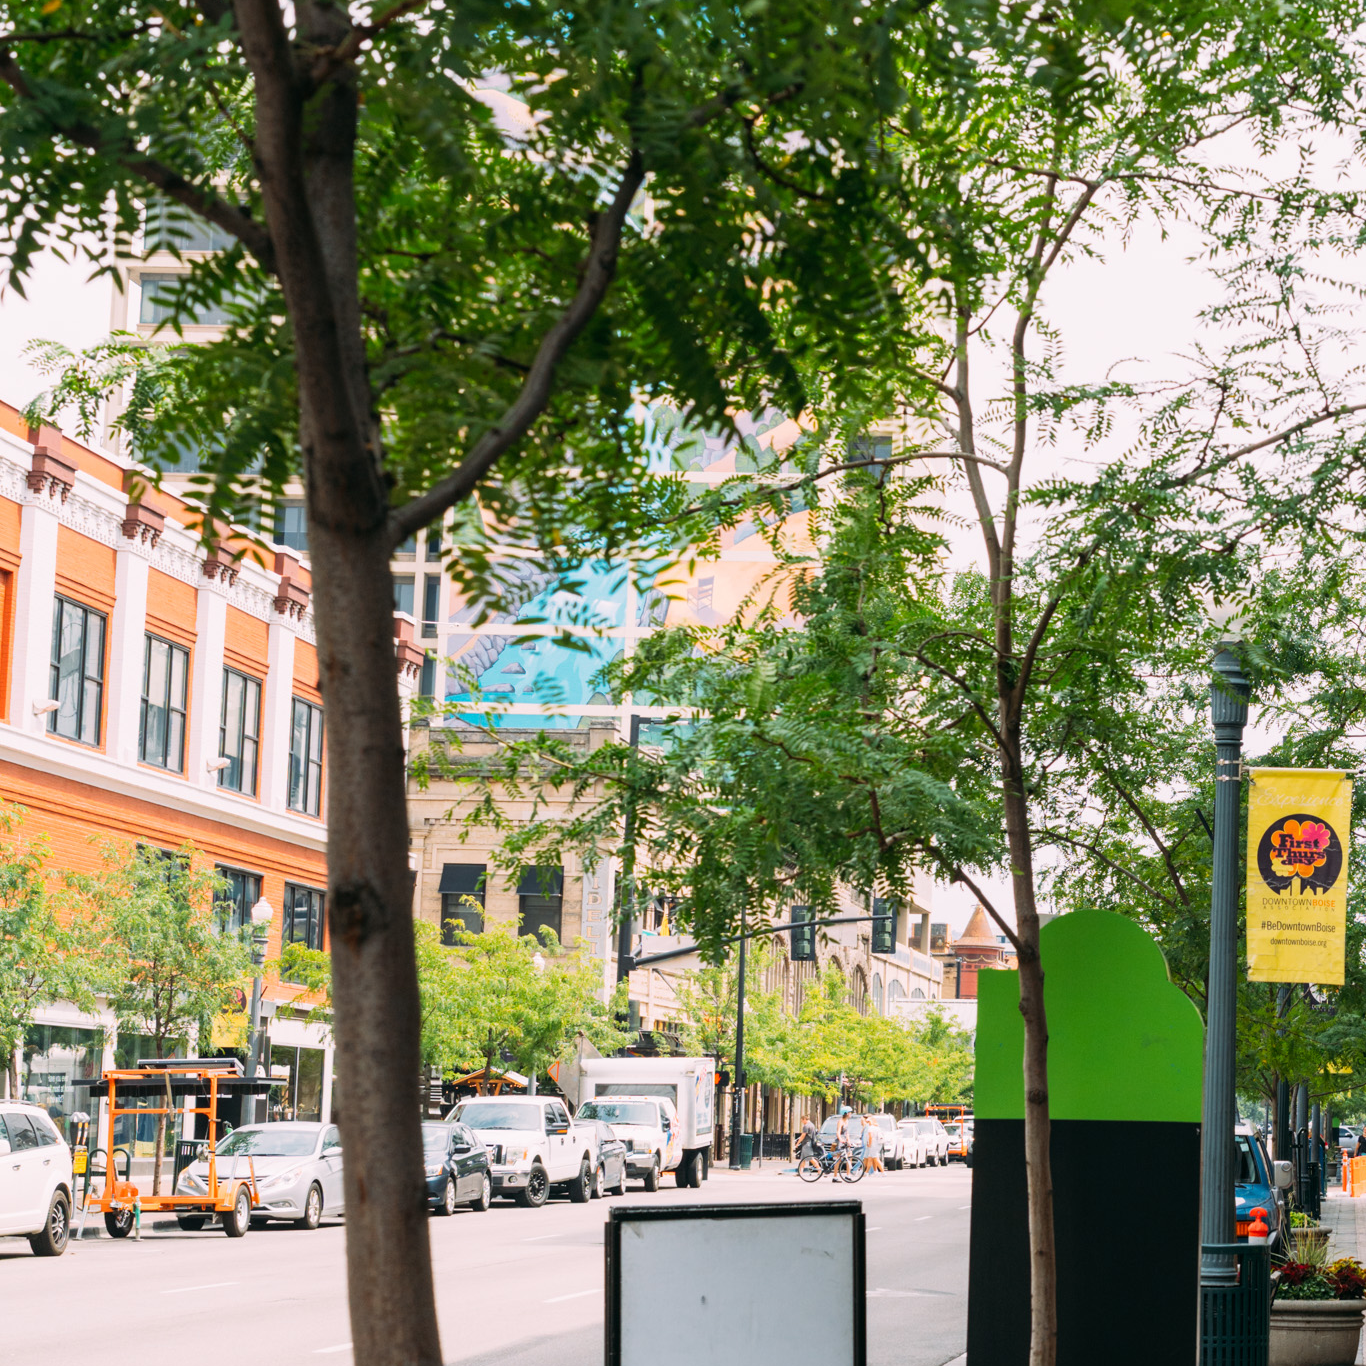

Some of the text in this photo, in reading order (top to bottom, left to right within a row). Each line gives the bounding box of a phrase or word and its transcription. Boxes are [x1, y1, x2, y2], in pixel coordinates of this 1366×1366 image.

[1256, 786, 1344, 809] Experience
[1278, 833, 1320, 849] First
[1272, 847, 1326, 860] Thurs
[1281, 858, 1317, 866] day
[1261, 920, 1336, 933] #BeDowntownBoise
[1270, 937, 1328, 948] downtownboise.org
